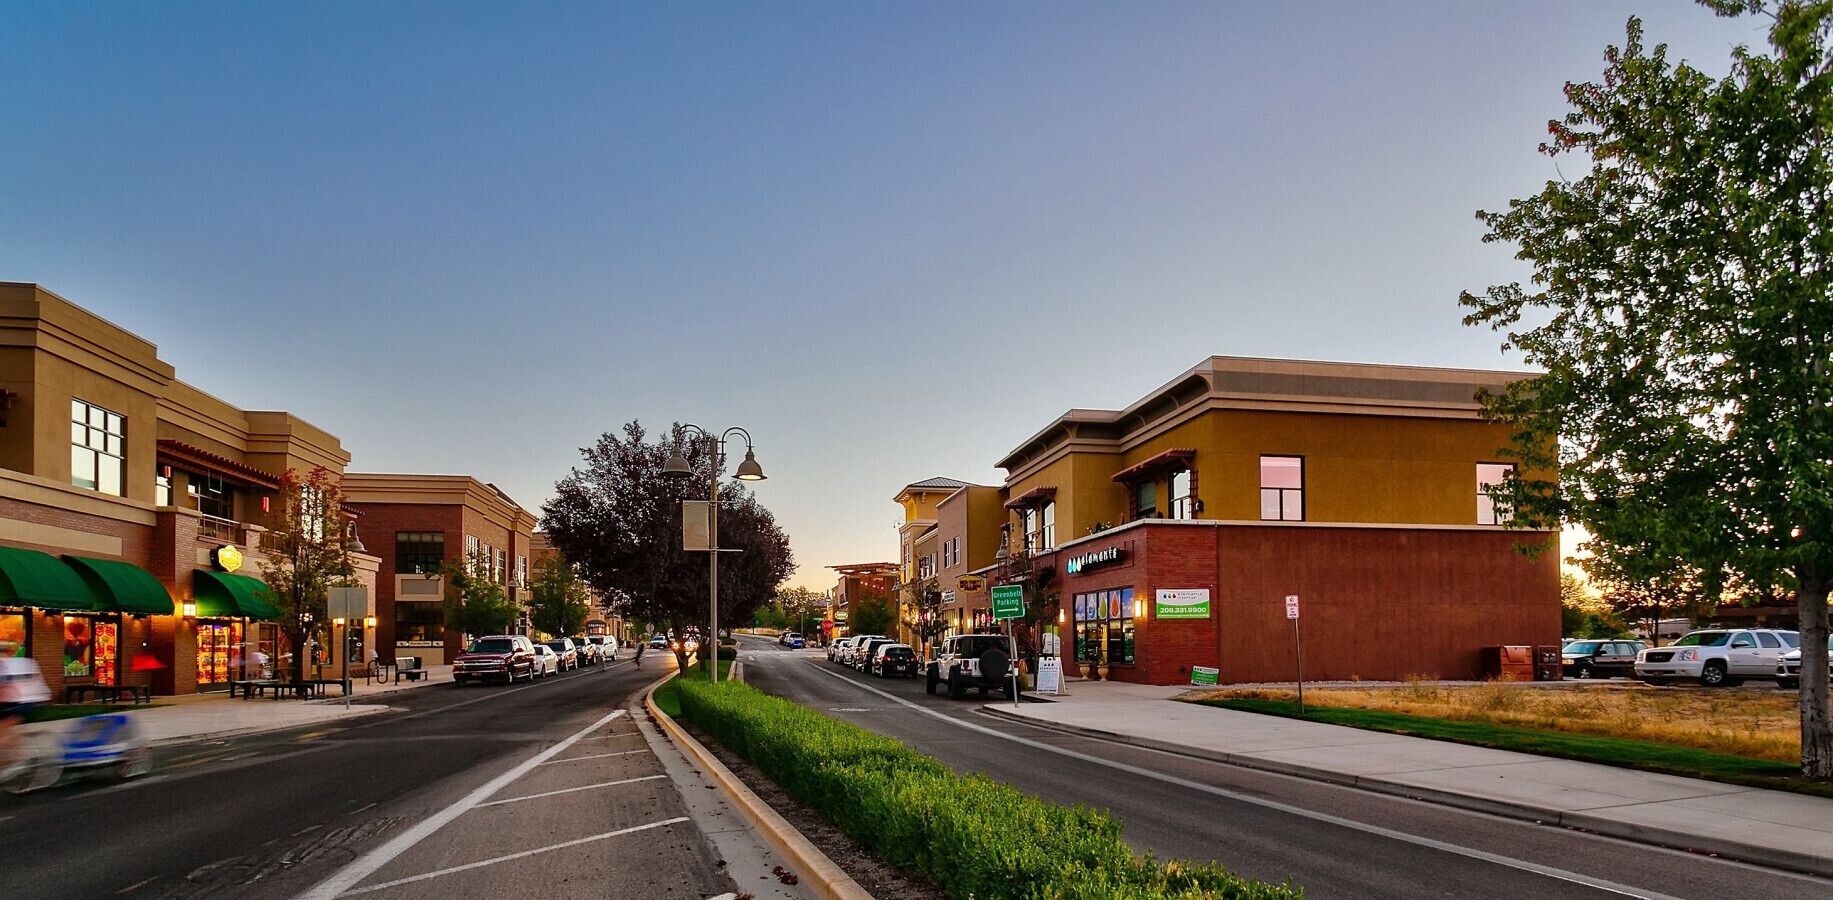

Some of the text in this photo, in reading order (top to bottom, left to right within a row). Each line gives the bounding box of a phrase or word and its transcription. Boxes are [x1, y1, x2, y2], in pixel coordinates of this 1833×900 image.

[1080, 547, 1117, 566] elements
[993, 591, 1021, 599] Greenbelt
[996, 598, 1019, 606] Parking
